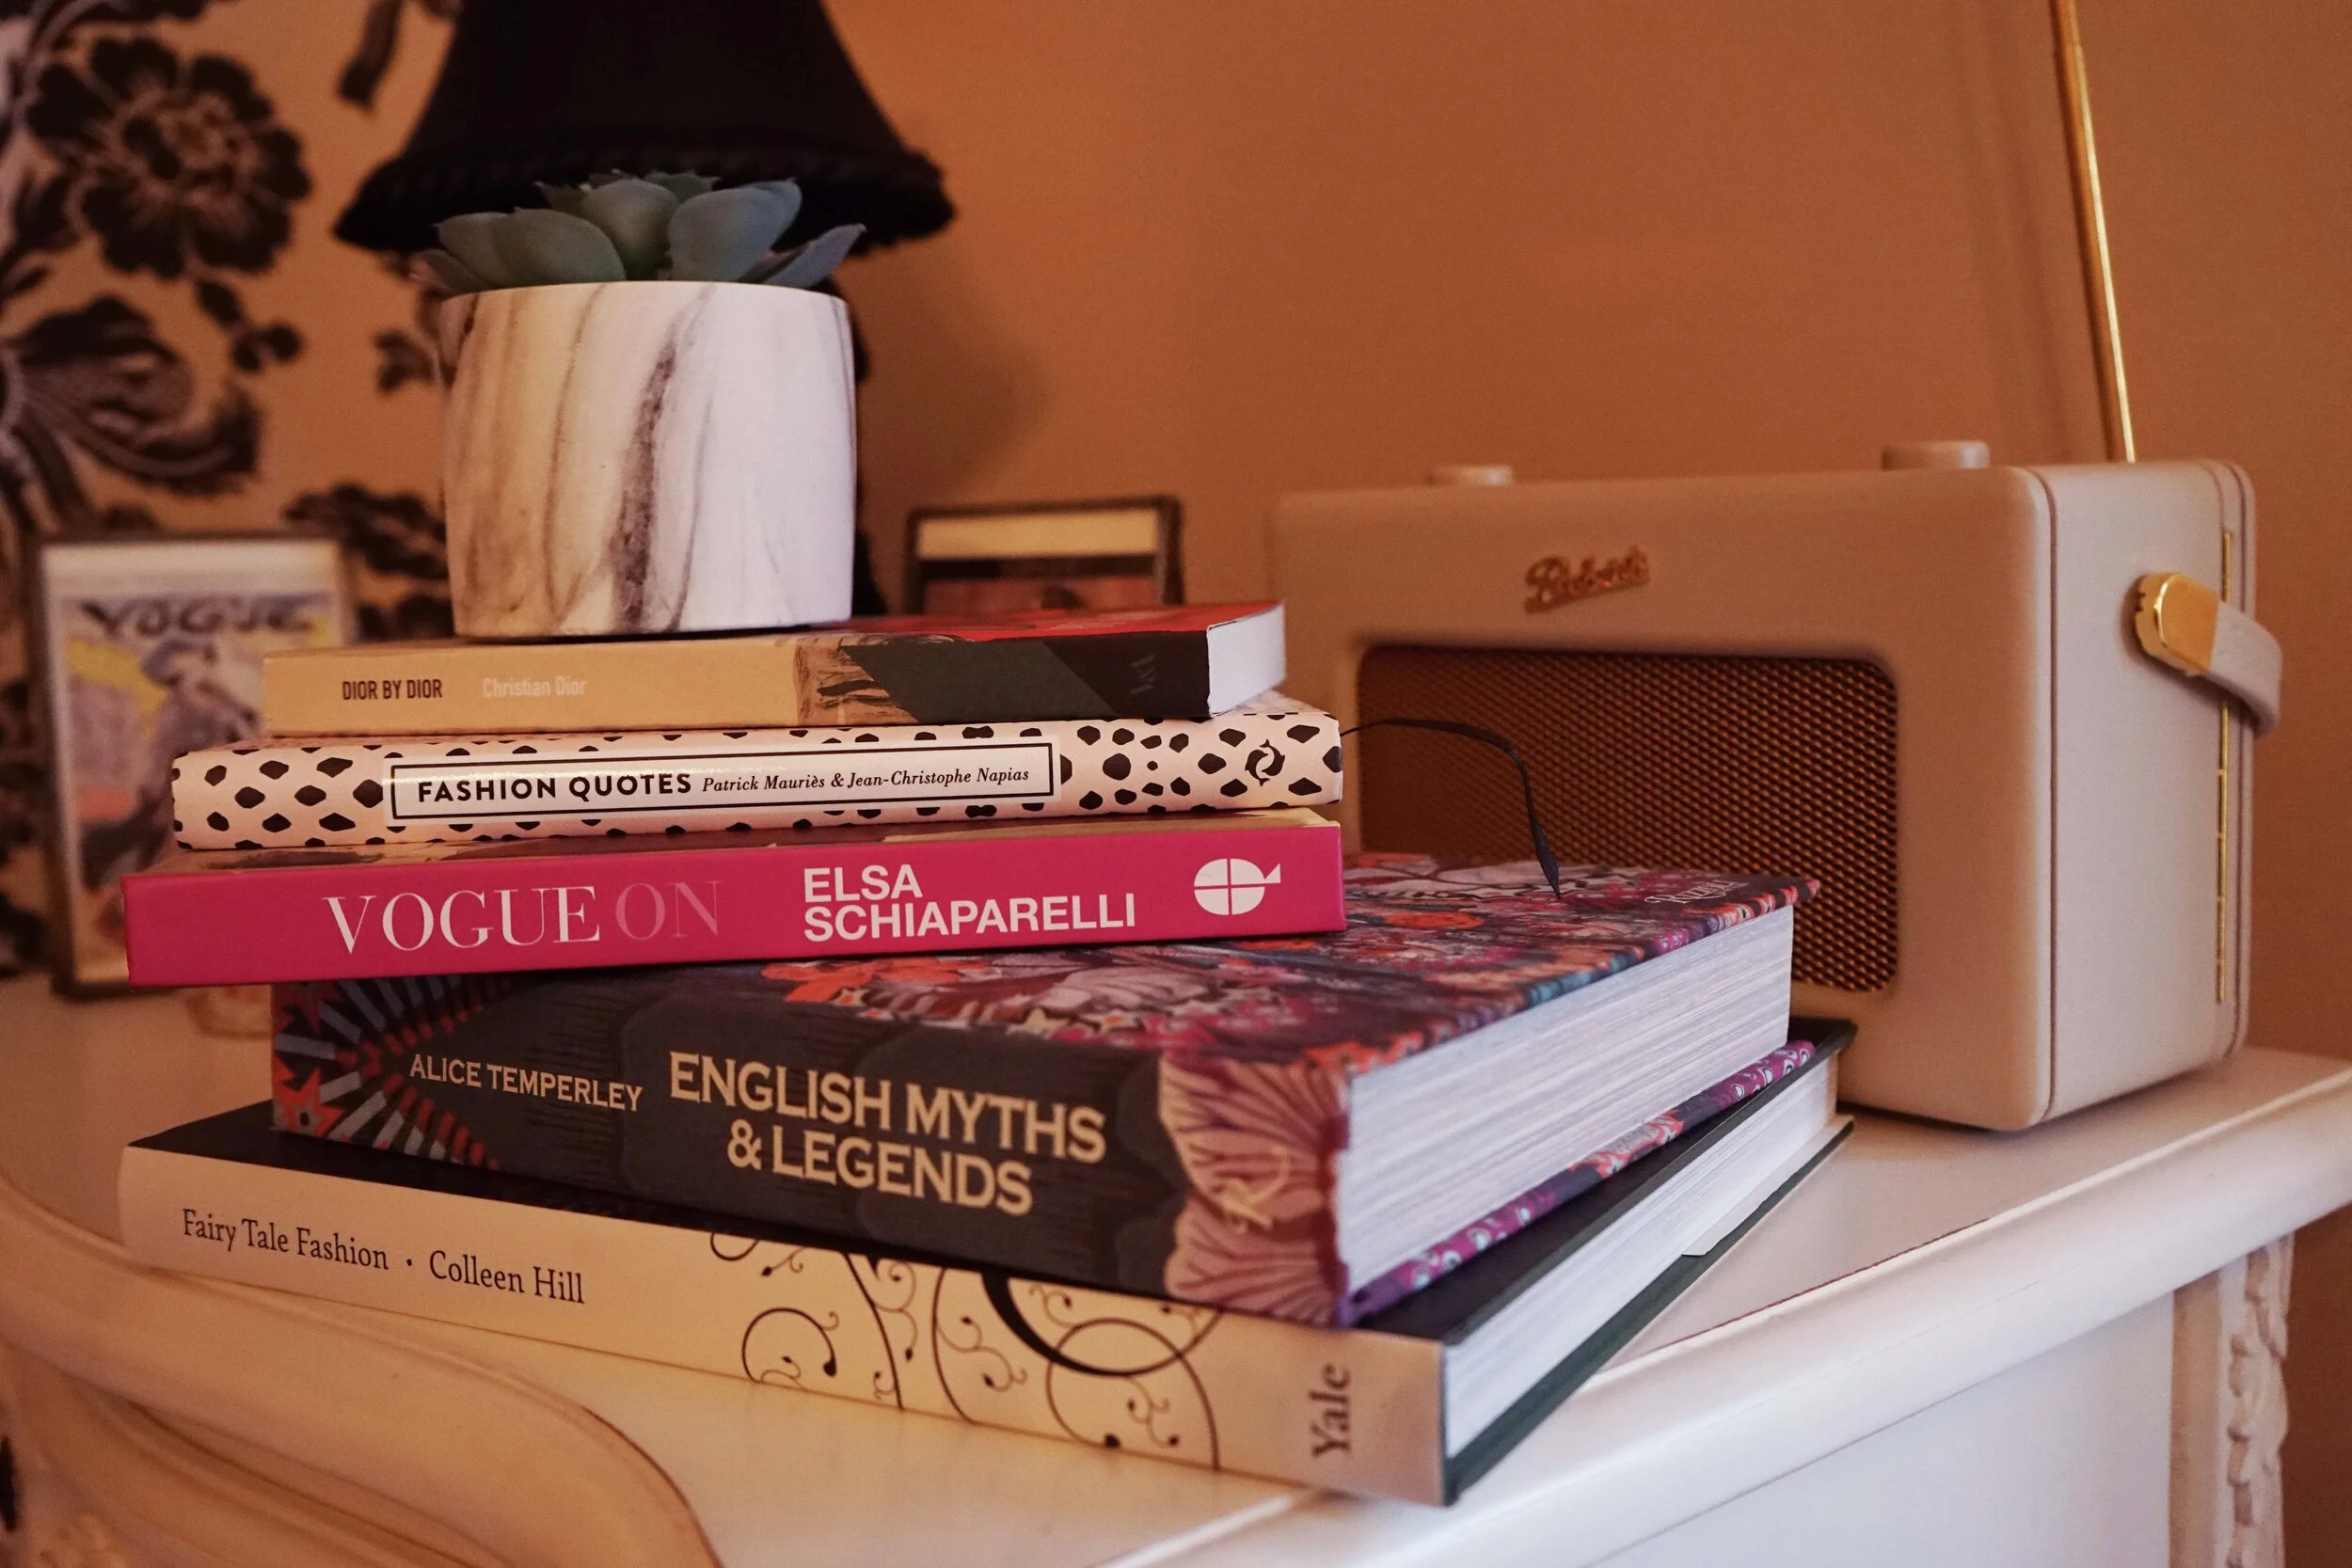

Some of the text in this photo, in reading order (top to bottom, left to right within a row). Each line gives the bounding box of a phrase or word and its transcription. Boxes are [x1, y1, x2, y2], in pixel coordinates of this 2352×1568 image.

[81, 595, 315, 639] VOGUE
[342, 678, 443, 700] DIOR BY DIOR
[483, 675, 586, 698] Christian Dior
[418, 773, 691, 802] FASHION QUOTES
[702, 767, 1029, 792] Patrick Mauriès & Jean-Christophe Napias
[803, 863, 923, 903] ELSA
[322, 879, 722, 954] VOGUE ON
[803, 893, 1136, 942] SCHIAPARELLI
[408, 1053, 644, 1112] ALICE TEMPERLEY
[670, 1051, 1107, 1164] ENGLISH MYTHS
[727, 1118, 1034, 1215] & LEGENDS
[183, 1208, 236, 1252] Fairy
[242, 1218, 289, 1253] Tale
[295, 1227, 389, 1271] Fashion
[430, 1250, 524, 1293] Colleen
[532, 1266, 585, 1304] Hill
[1309, 1363, 1351, 1457] Yale
